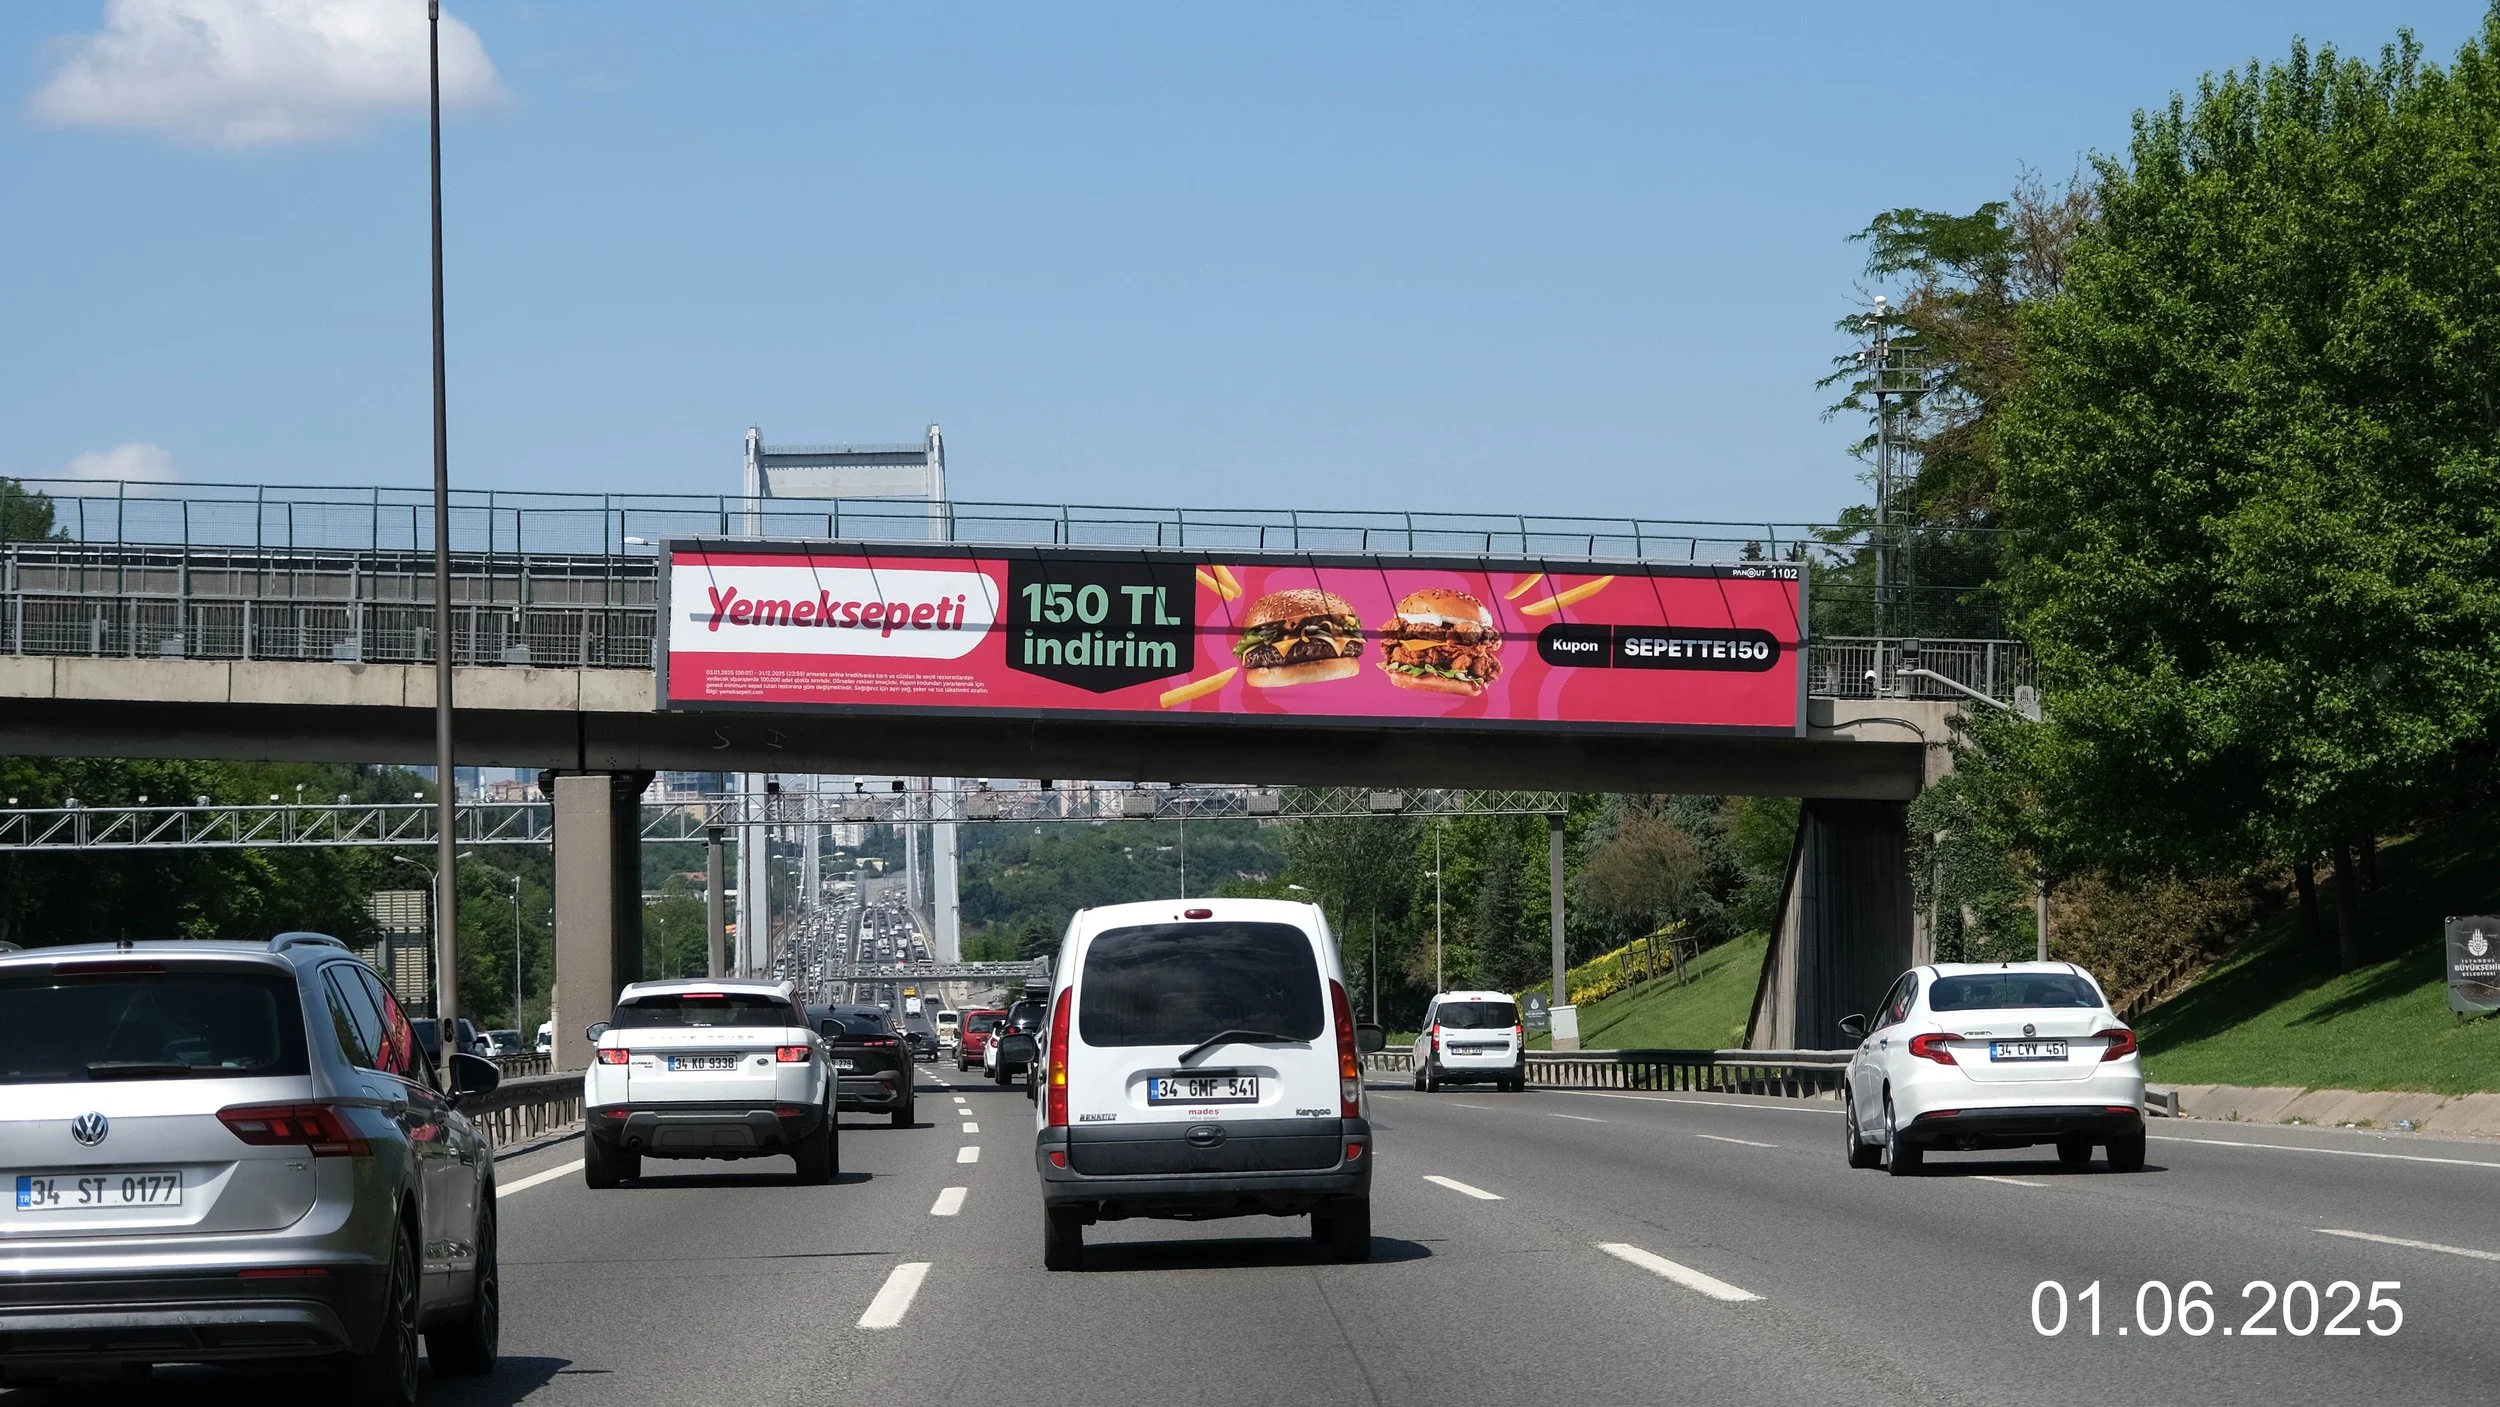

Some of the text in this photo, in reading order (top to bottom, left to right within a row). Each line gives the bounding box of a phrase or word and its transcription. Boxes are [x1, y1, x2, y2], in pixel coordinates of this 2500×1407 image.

[1771, 568, 1798, 578] 1102
[707, 586, 967, 638] Yemeksepeti
[1022, 583, 1181, 625] 150 TL
[1023, 628, 1177, 668] indirim
[1553, 638, 1598, 653] Kupon
[1624, 637, 1769, 660] SEPETTE150
[1999, 1044, 2011, 1056] 34
[2046, 1043, 2064, 1054] 461
[676, 1058, 688, 1069] 34
[709, 1057, 734, 1068] 9338
[1160, 1078, 1255, 1097] 34 GMF 541
[1188, 1108, 1220, 1116] mades
[32, 1176, 177, 1205] 34 ST 0177
